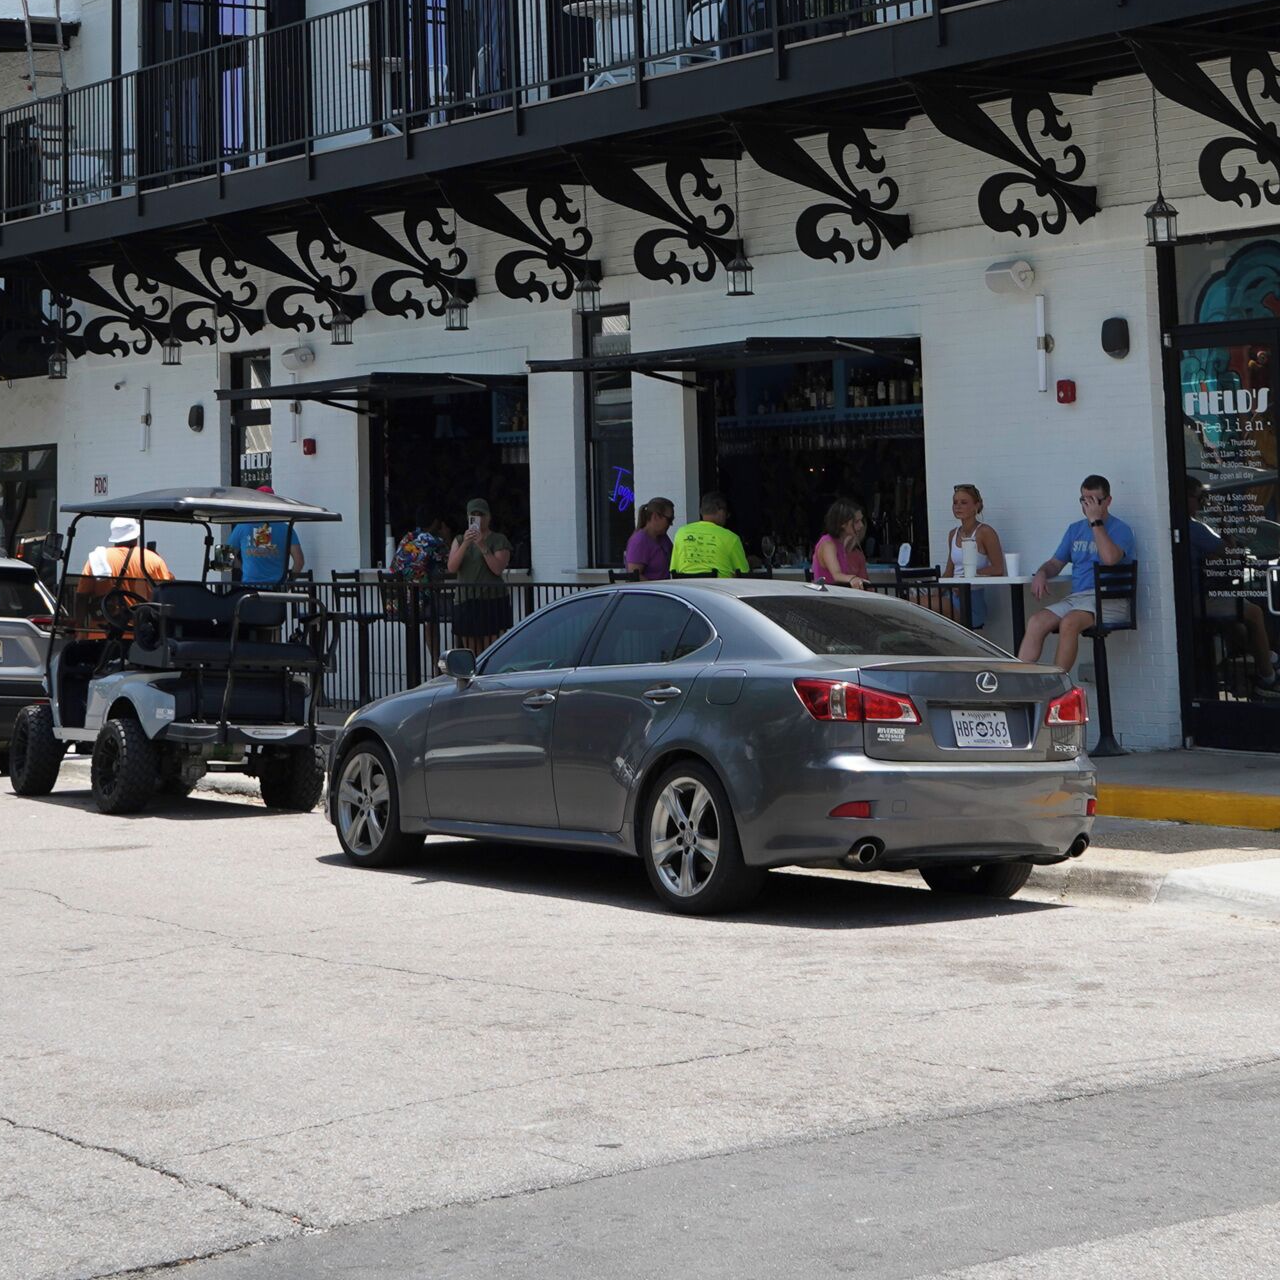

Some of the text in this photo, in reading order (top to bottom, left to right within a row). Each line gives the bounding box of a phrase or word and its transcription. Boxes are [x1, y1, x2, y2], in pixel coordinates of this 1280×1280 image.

[1184, 387, 1270, 416] FIELD'S
[1230, 438, 1257, 447] Thursday
[1220, 473, 1235, 481] open
[94, 477, 107, 494] FDC
[1208, 494, 1225, 502] Friday
[1231, 493, 1258, 502] Saturday
[1223, 527, 1238, 535] open
[1246, 526, 1258, 535] day
[1224, 547, 1246, 555] Sunday
[1208, 590, 1268, 598] NO PUBLIC RESTROOMS
[955, 720, 1007, 738] HBF 363
